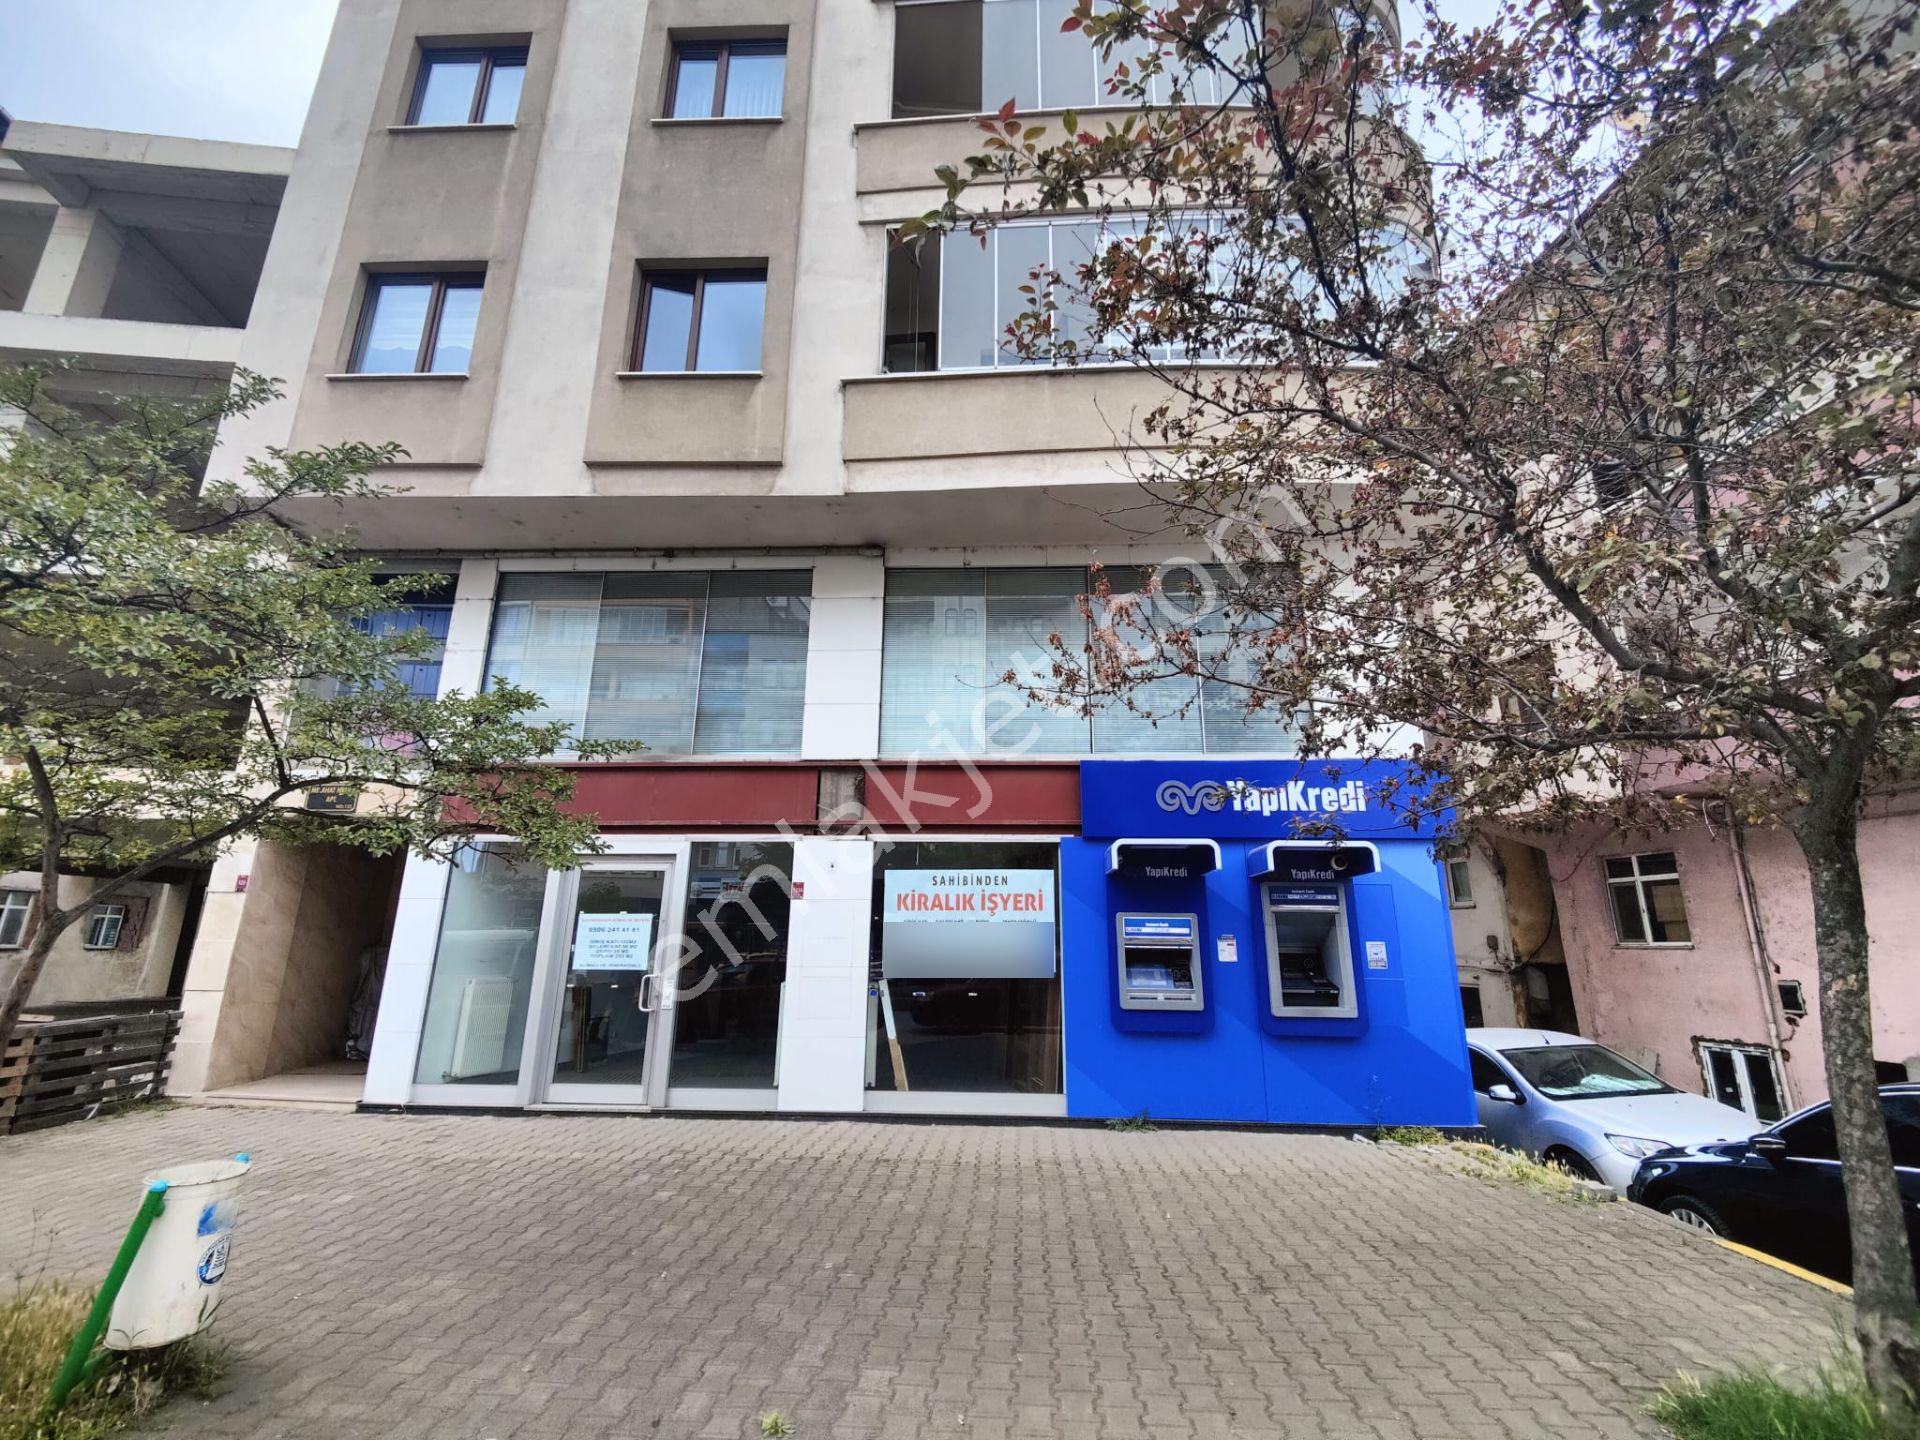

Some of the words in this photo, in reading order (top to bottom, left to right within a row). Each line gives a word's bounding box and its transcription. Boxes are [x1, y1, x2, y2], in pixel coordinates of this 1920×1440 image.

[932, 872, 1008, 886] SAHİBİNDEN
[1145, 866, 1188, 879] YapıKredi
[1290, 868, 1335, 881] YapıKredi
[896, 889, 975, 912] KİRALIK
[980, 889, 1044, 916] İŞYERİ
